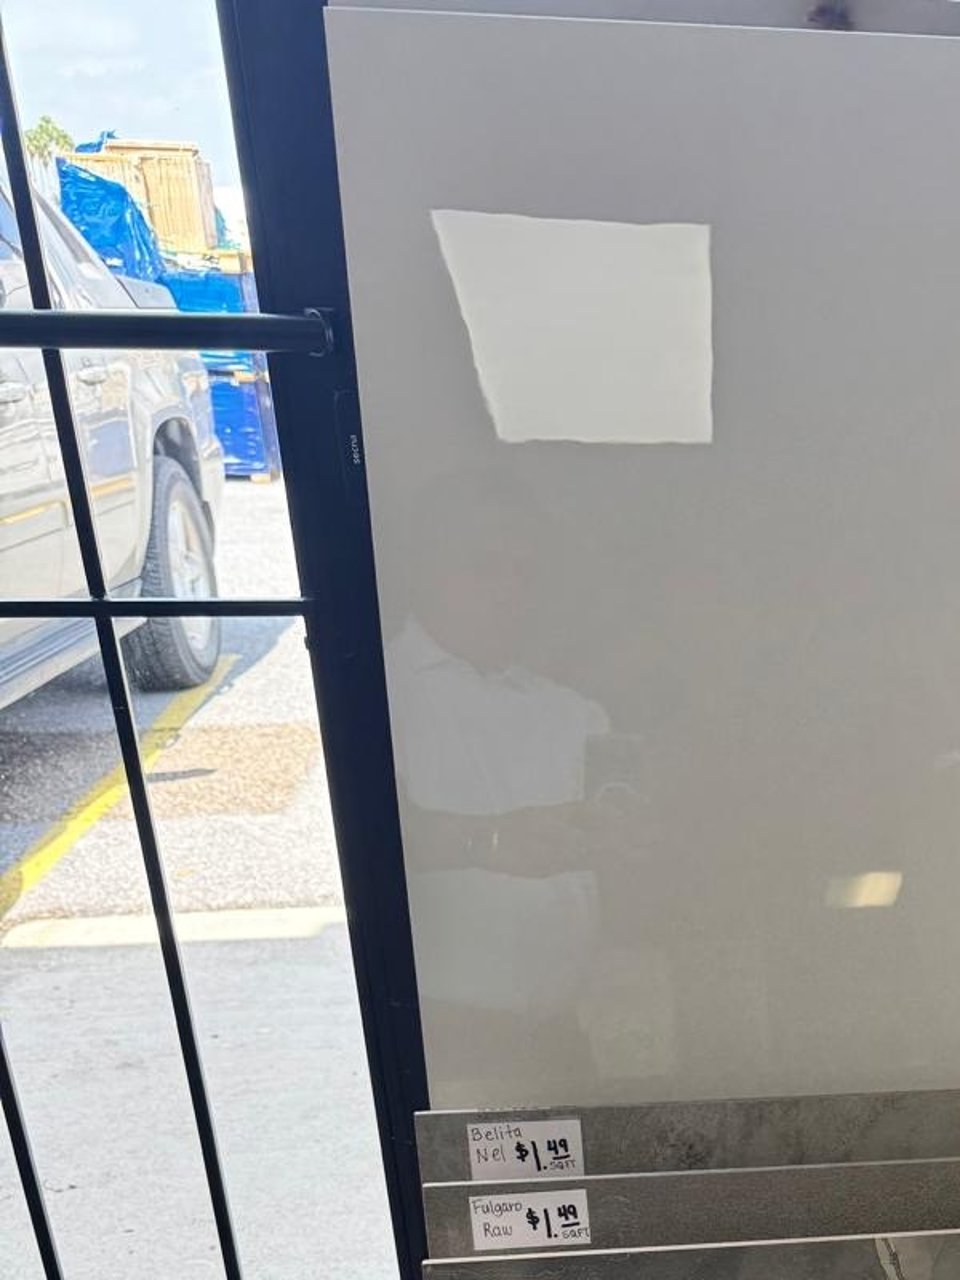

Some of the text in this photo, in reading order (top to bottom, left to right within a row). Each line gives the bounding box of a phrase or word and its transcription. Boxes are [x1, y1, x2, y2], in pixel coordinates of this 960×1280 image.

[471, 1124, 523, 1142] Belita
[476, 1146, 506, 1163] Nel
[472, 1199, 523, 1217] Fulgaro
[483, 1222, 513, 1238] Raw
